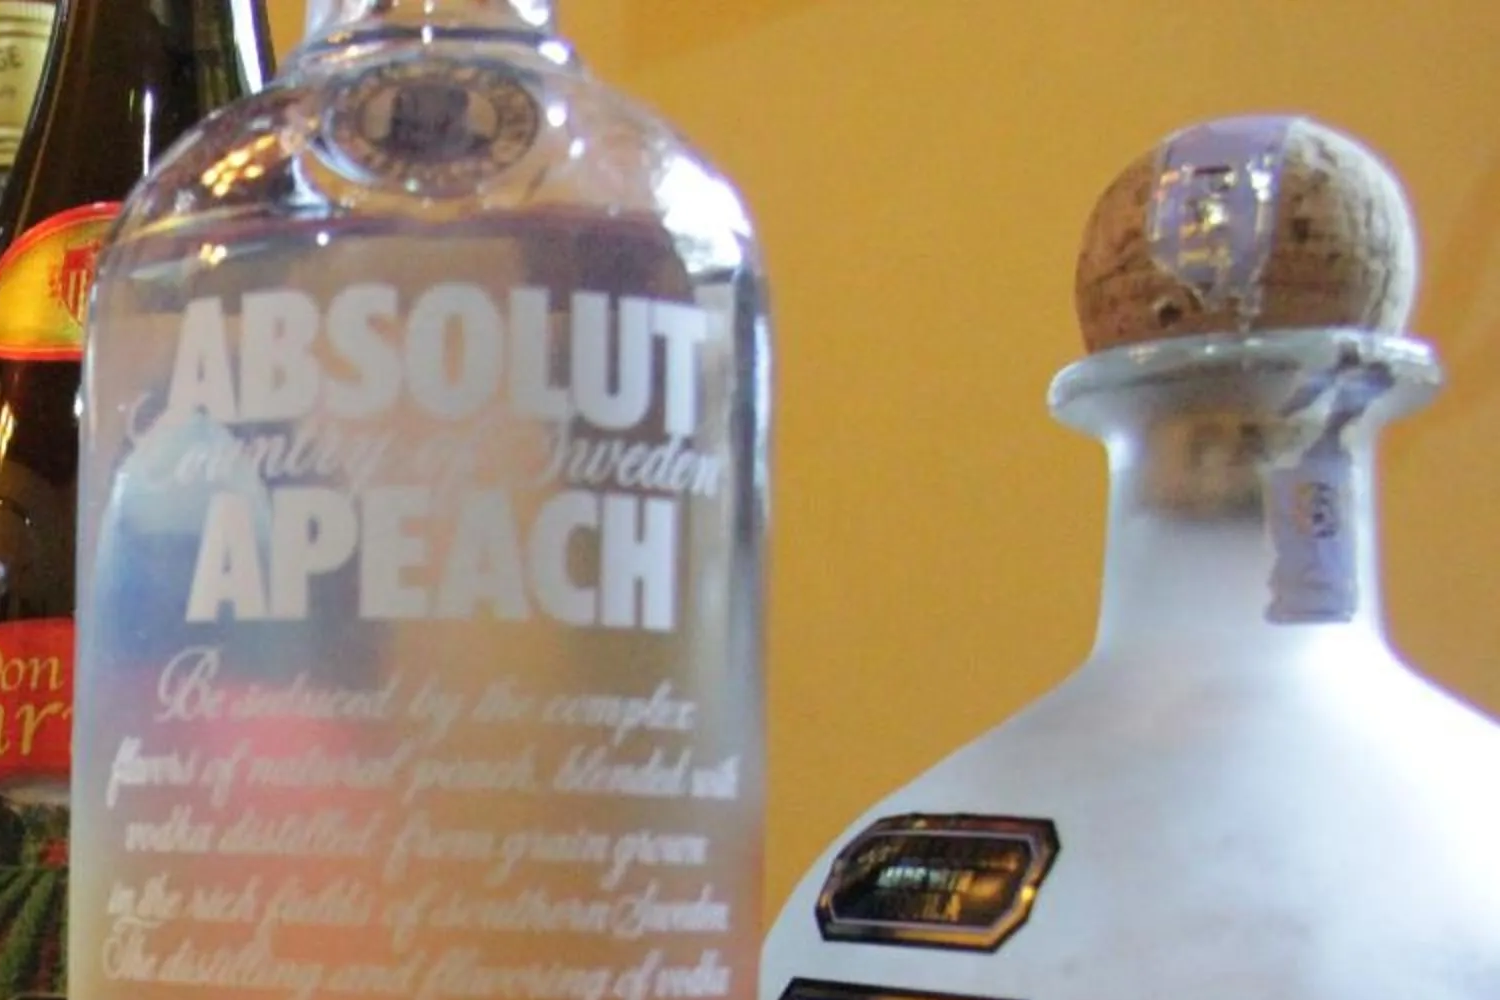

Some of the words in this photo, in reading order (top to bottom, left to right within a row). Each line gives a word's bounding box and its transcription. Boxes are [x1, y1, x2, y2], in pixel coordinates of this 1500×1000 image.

[166, 281, 708, 436] ABSOLUT
[532, 416, 717, 497] Sweden
[186, 488, 674, 631] APEACH
